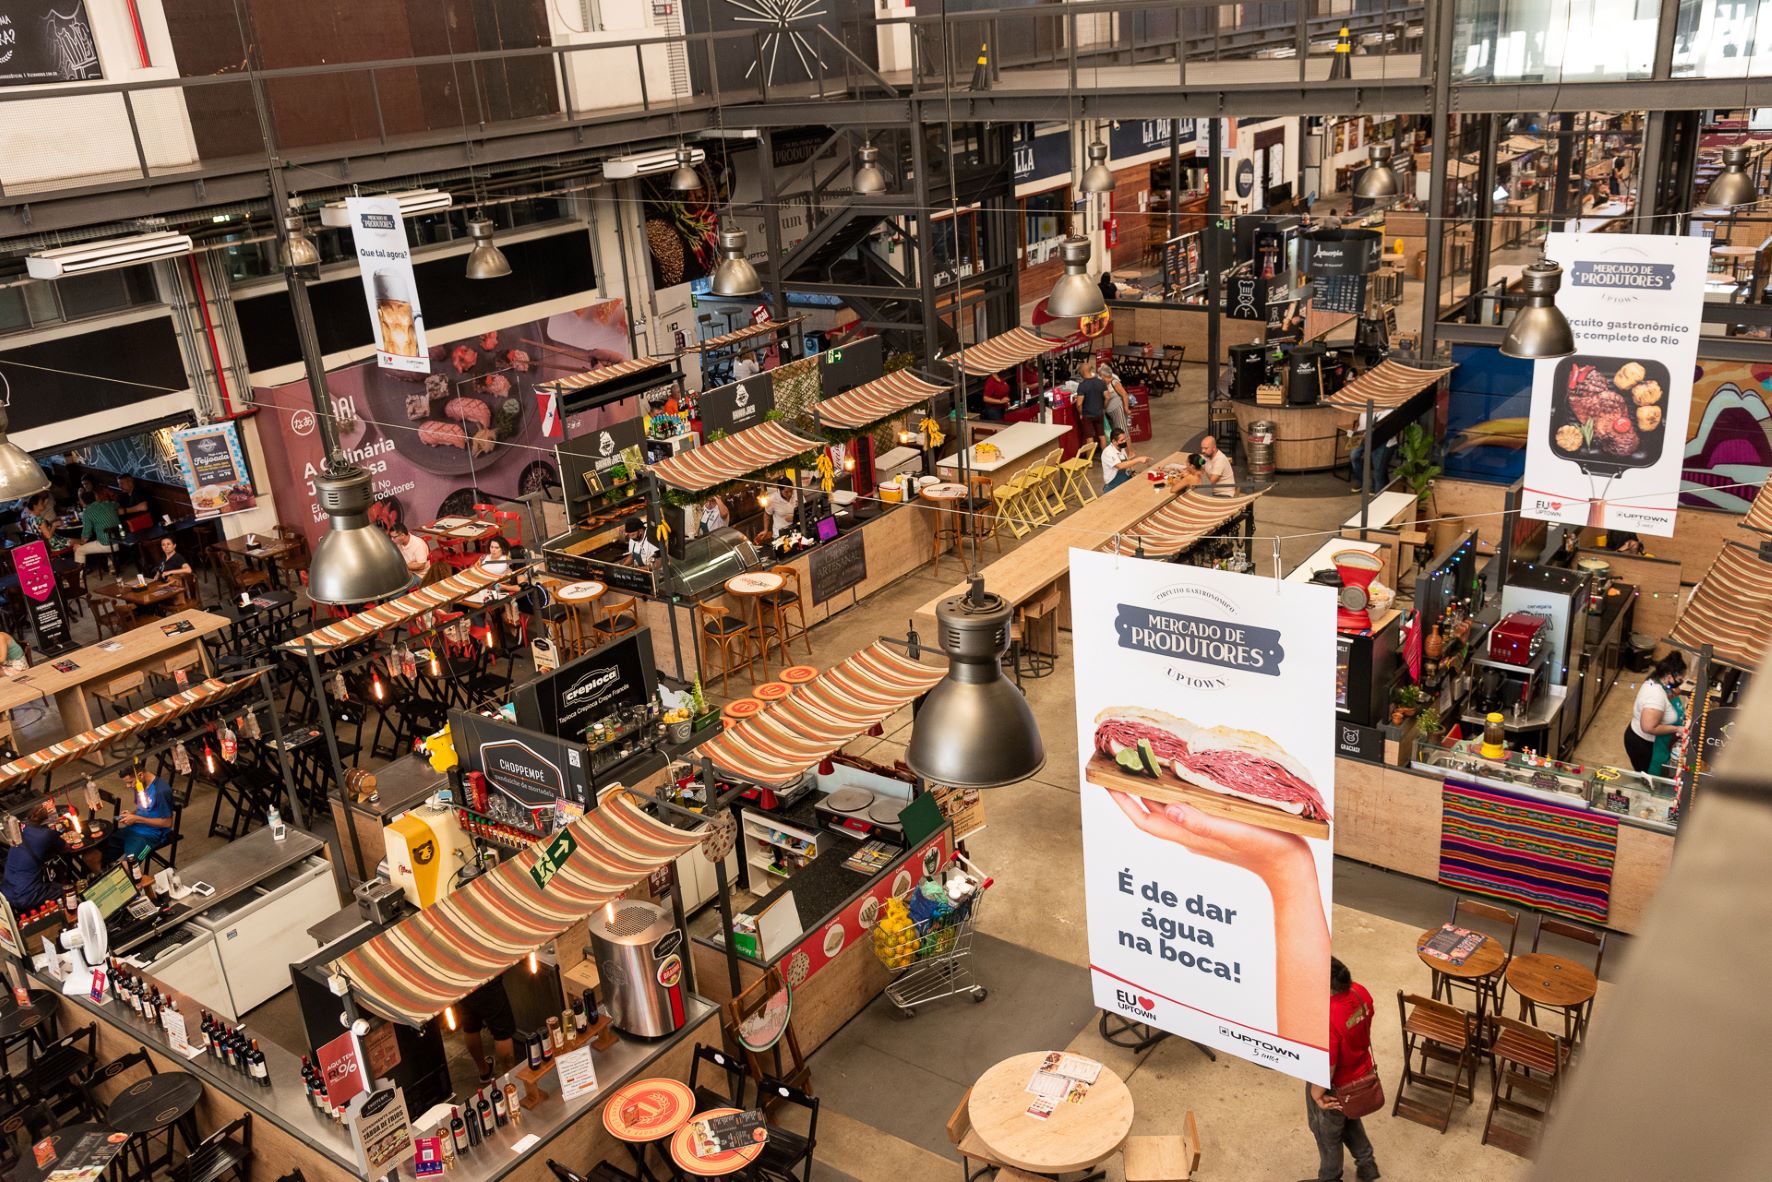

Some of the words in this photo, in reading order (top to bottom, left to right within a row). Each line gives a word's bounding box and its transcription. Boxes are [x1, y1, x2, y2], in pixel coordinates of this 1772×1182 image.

[1142, 122, 1154, 144] LA
[1156, 119, 1194, 140] PARLLA
[360, 248, 375, 257] Que
[376, 249, 386, 257] tal
[386, 251, 408, 260] agora?
[1580, 273, 1664, 287] PRODUTORES
[1593, 264, 1639, 275] MERCADO
[1640, 266, 1653, 275] DE
[1567, 318, 1604, 328] rcuito
[1607, 319, 1689, 333] gastronômico
[1583, 331, 1639, 343] completo
[1642, 334, 1657, 345] do
[1660, 336, 1680, 346] Rio
[304, 462, 318, 479] A
[320, 437, 395, 471] Clinária
[374, 480, 415, 501] rodutores
[1623, 513, 1668, 524] UPTOWN
[1156, 587, 1185, 601] CIRCUITO
[1148, 614, 1221, 640] MERCADO
[1225, 627, 1246, 644] DE
[1131, 626, 1264, 668] PRODUTORES
[565, 670, 618, 701] crepioca
[1167, 667, 1226, 689] UPTOWN
[499, 758, 545, 782] CHOPPEMPÉ
[1118, 867, 1134, 895] É
[1141, 881, 1178, 908] de
[1185, 894, 1237, 925] dar
[1141, 907, 1214, 948] água
[1118, 930, 1152, 955] na
[1159, 937, 1241, 983] boca!
[1116, 989, 1137, 1006] EU
[1117, 1002, 1157, 1021] UPTOWN
[1230, 1030, 1300, 1061] UPTOWN
[327, 1058, 342, 1071] AQUI
[342, 1051, 355, 1061] TEM
